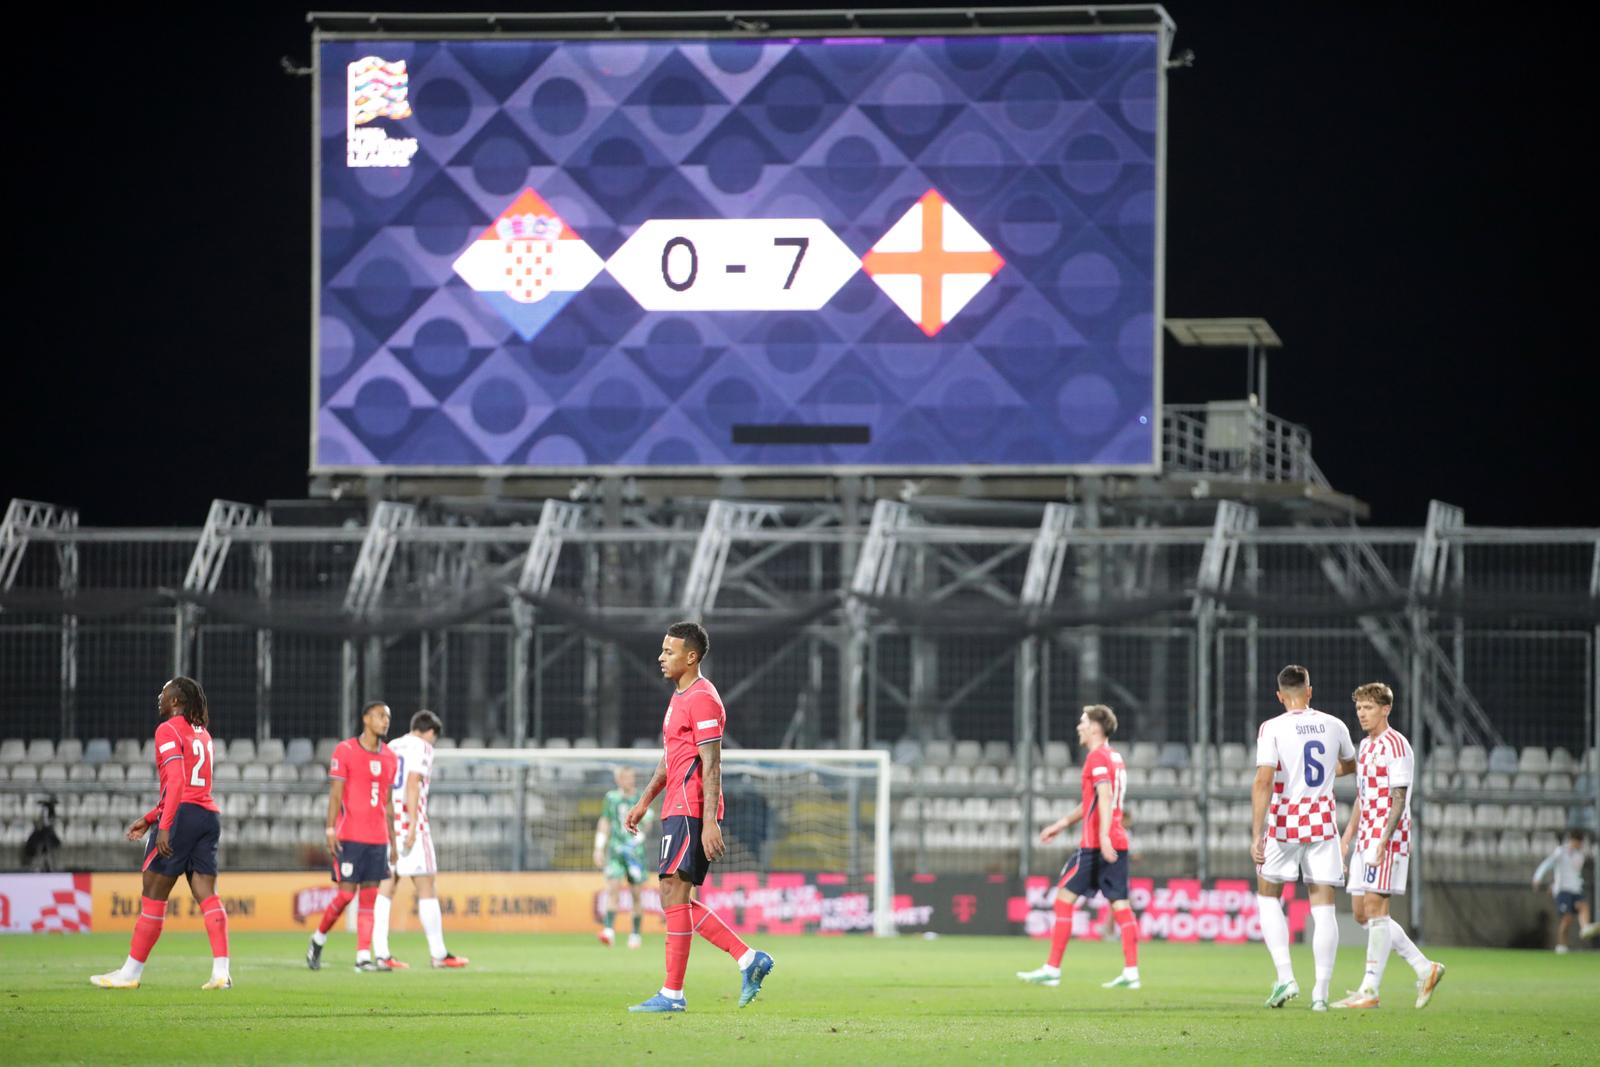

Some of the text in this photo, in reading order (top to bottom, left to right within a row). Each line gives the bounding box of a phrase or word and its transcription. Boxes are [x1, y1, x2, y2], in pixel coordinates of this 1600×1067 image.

[661, 236, 698, 292] 0
[773, 237, 810, 290] 7
[1303, 739, 1325, 788] 6
[369, 781, 379, 808] 5
[660, 834, 673, 860] 17
[1363, 863, 1377, 884] 18
